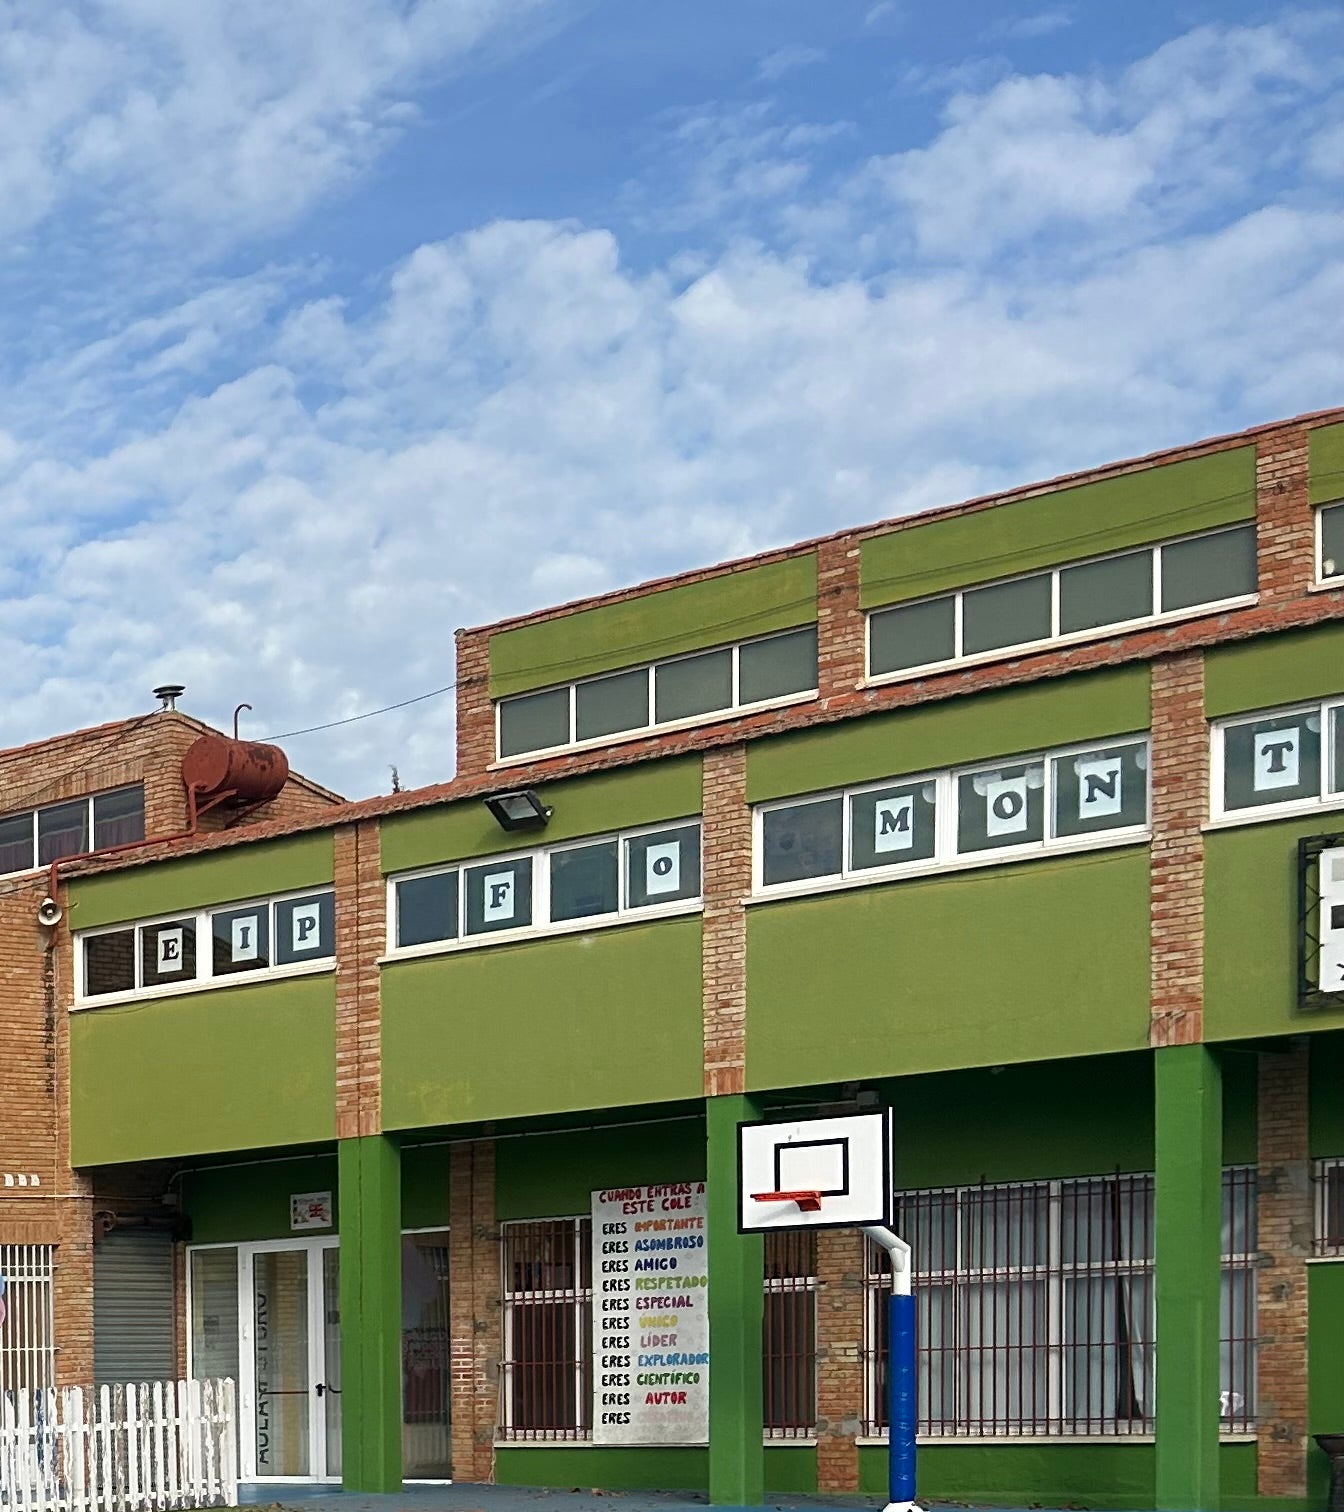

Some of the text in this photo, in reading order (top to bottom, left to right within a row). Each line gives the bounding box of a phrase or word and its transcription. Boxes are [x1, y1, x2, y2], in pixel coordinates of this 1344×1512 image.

[599, 1188, 642, 1203] CUANDO
[647, 1183, 692, 1199] ENTRAS
[623, 1196, 692, 1215] ESTE COLE
[602, 1217, 704, 1235] ERES IMPORTANTE
[602, 1235, 704, 1254] ERES ASOMBROSO
[601, 1257, 677, 1273] ERES AMIGO
[602, 1275, 708, 1292] ERES RESPETADO
[602, 1295, 694, 1311] ERES ESPECIAL
[602, 1317, 630, 1330] ERES
[602, 1331, 678, 1349] ERES LÍDER
[601, 1353, 709, 1368] ERES EXPLORADOR
[601, 1369, 700, 1387] ERES CIENTÍFICO
[602, 1391, 688, 1405] ERES AUTOR
[601, 1412, 631, 1424] ERES
